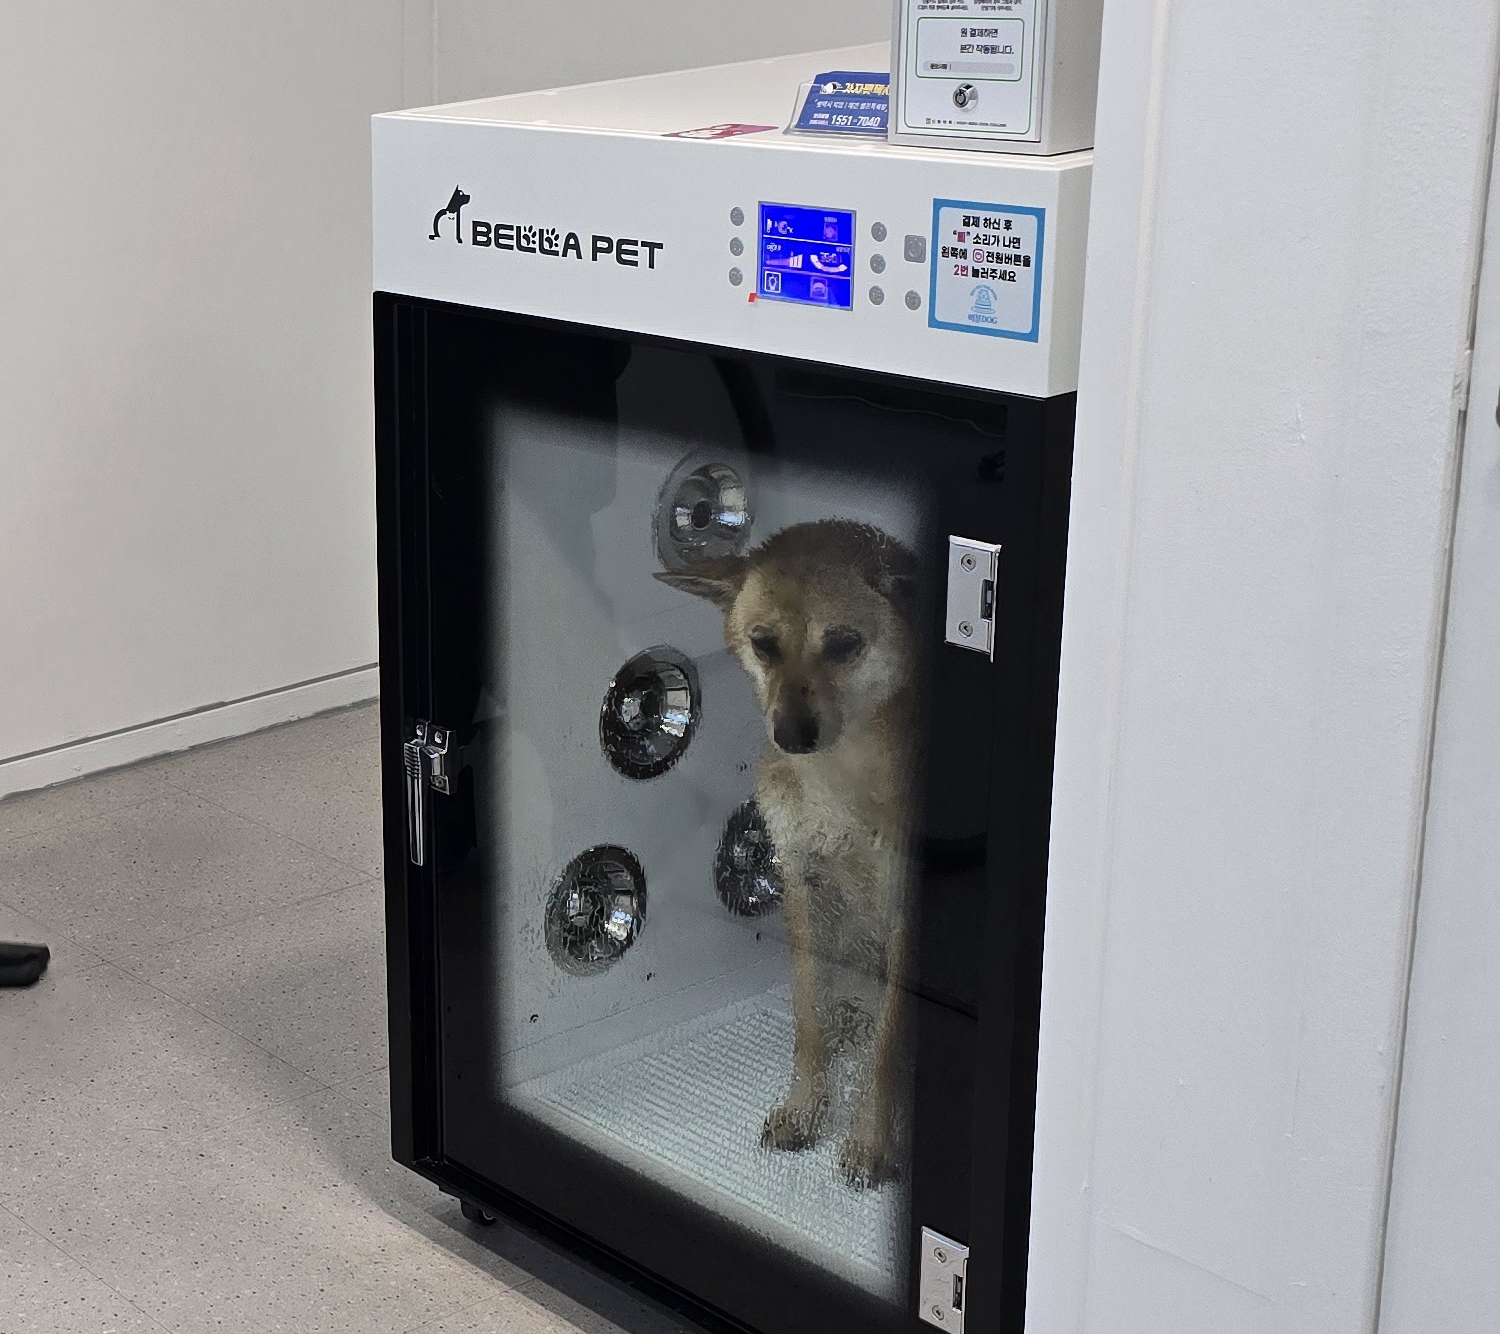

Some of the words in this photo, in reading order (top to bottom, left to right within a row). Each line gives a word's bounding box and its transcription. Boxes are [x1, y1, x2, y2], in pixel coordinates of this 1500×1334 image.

[962, 215, 981, 228] 결제
[982, 217, 1001, 230] 하신
[1003, 219, 1013, 232] 후
[471, 219, 583, 260] BELLA
[591, 234, 664, 269] PET
[972, 233, 1000, 247] 소리가
[1002, 235, 1021, 249] 나면
[941, 246, 968, 260] 왼쪽에
[953, 264, 969, 277] 2번
[971, 266, 1017, 283] 눌러주세요
